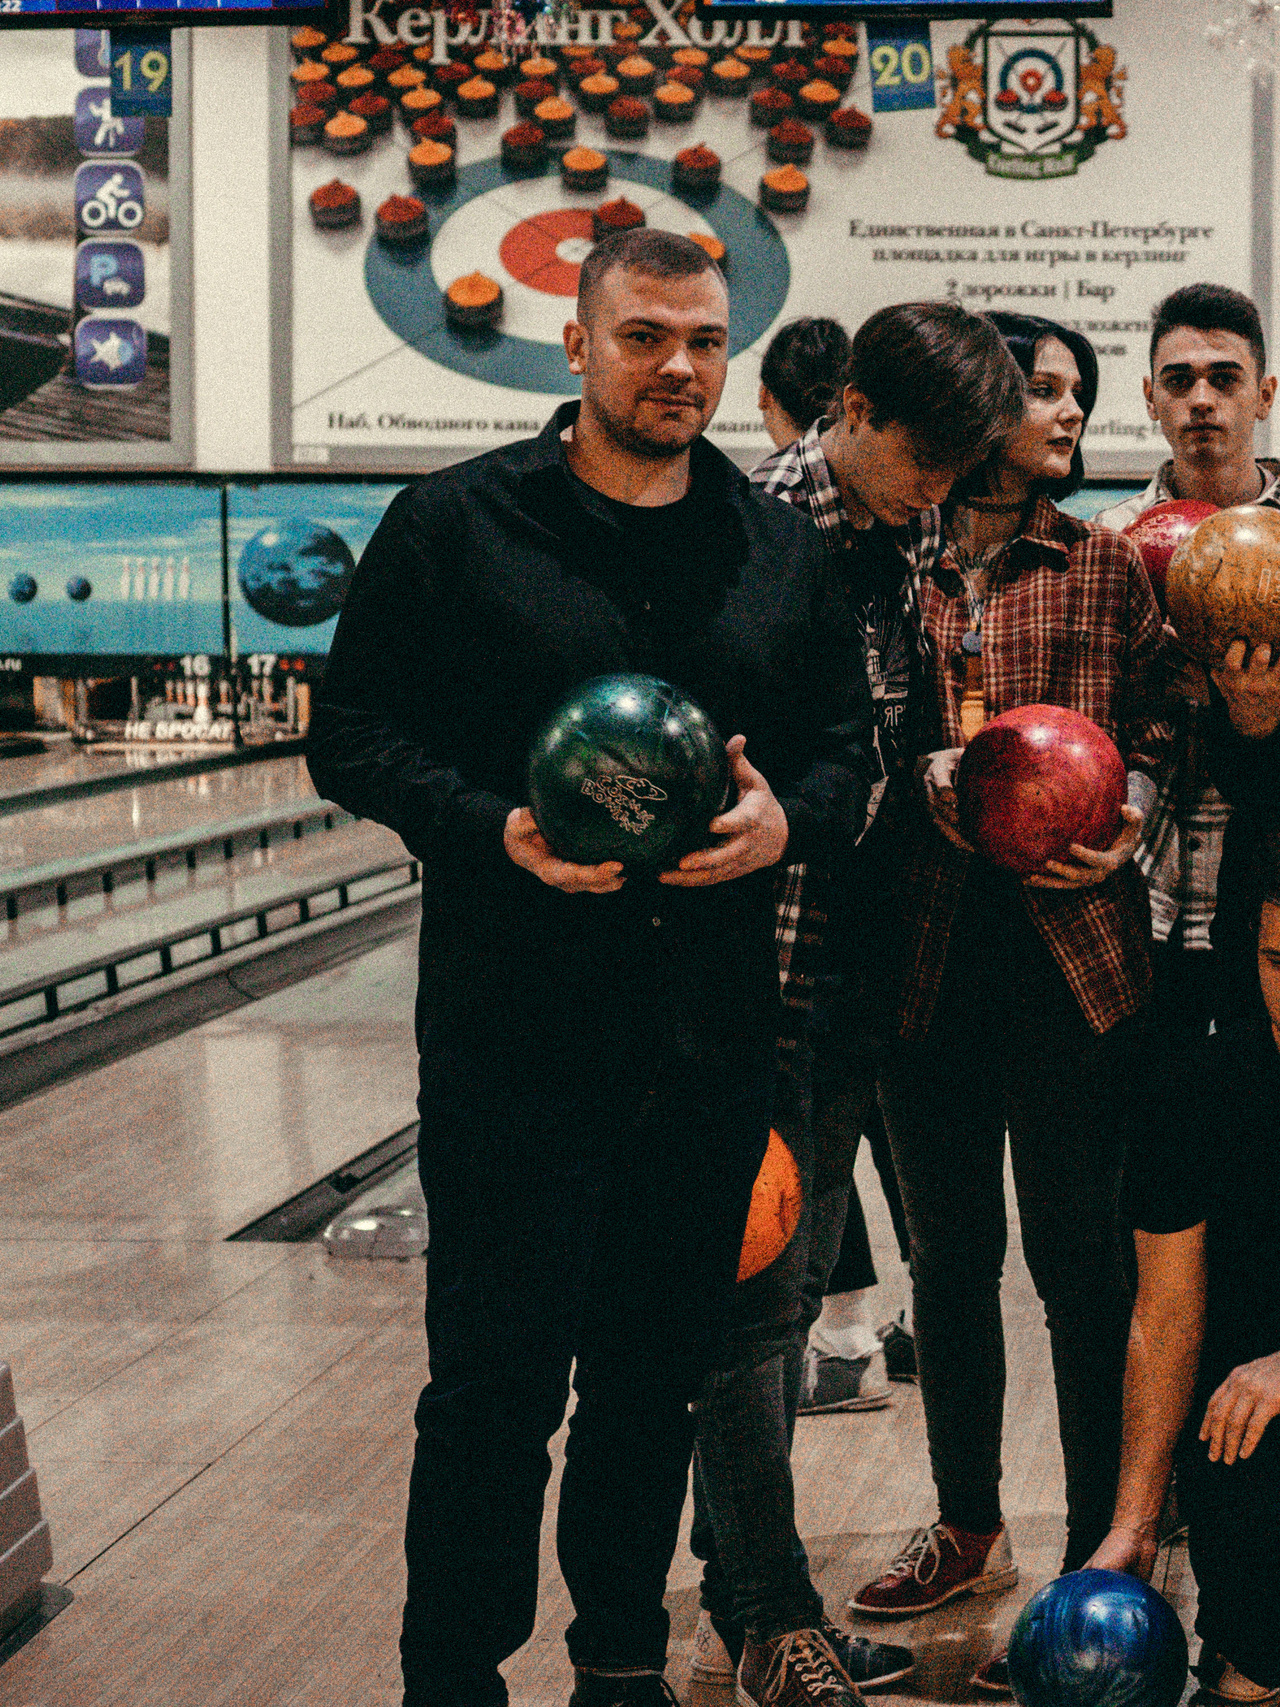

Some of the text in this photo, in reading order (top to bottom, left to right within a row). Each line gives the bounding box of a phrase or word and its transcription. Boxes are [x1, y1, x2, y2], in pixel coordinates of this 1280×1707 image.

[114, 51, 169, 92] 19
[872, 43, 931, 85] 20
[849, 219, 1214, 244] Единственная в Санкт-Петербурге
[873, 249, 1186, 268] площадка для игры в керлинг
[962, 284, 1057, 303] дорожки
[1077, 279, 1115, 303] Бар
[377, 413, 488, 431] Обводного
[493, 419, 540, 431] кана
[180, 655, 211, 677] 16
[248, 654, 277, 677] 17
[155, 720, 234, 740] БРОСАТ
